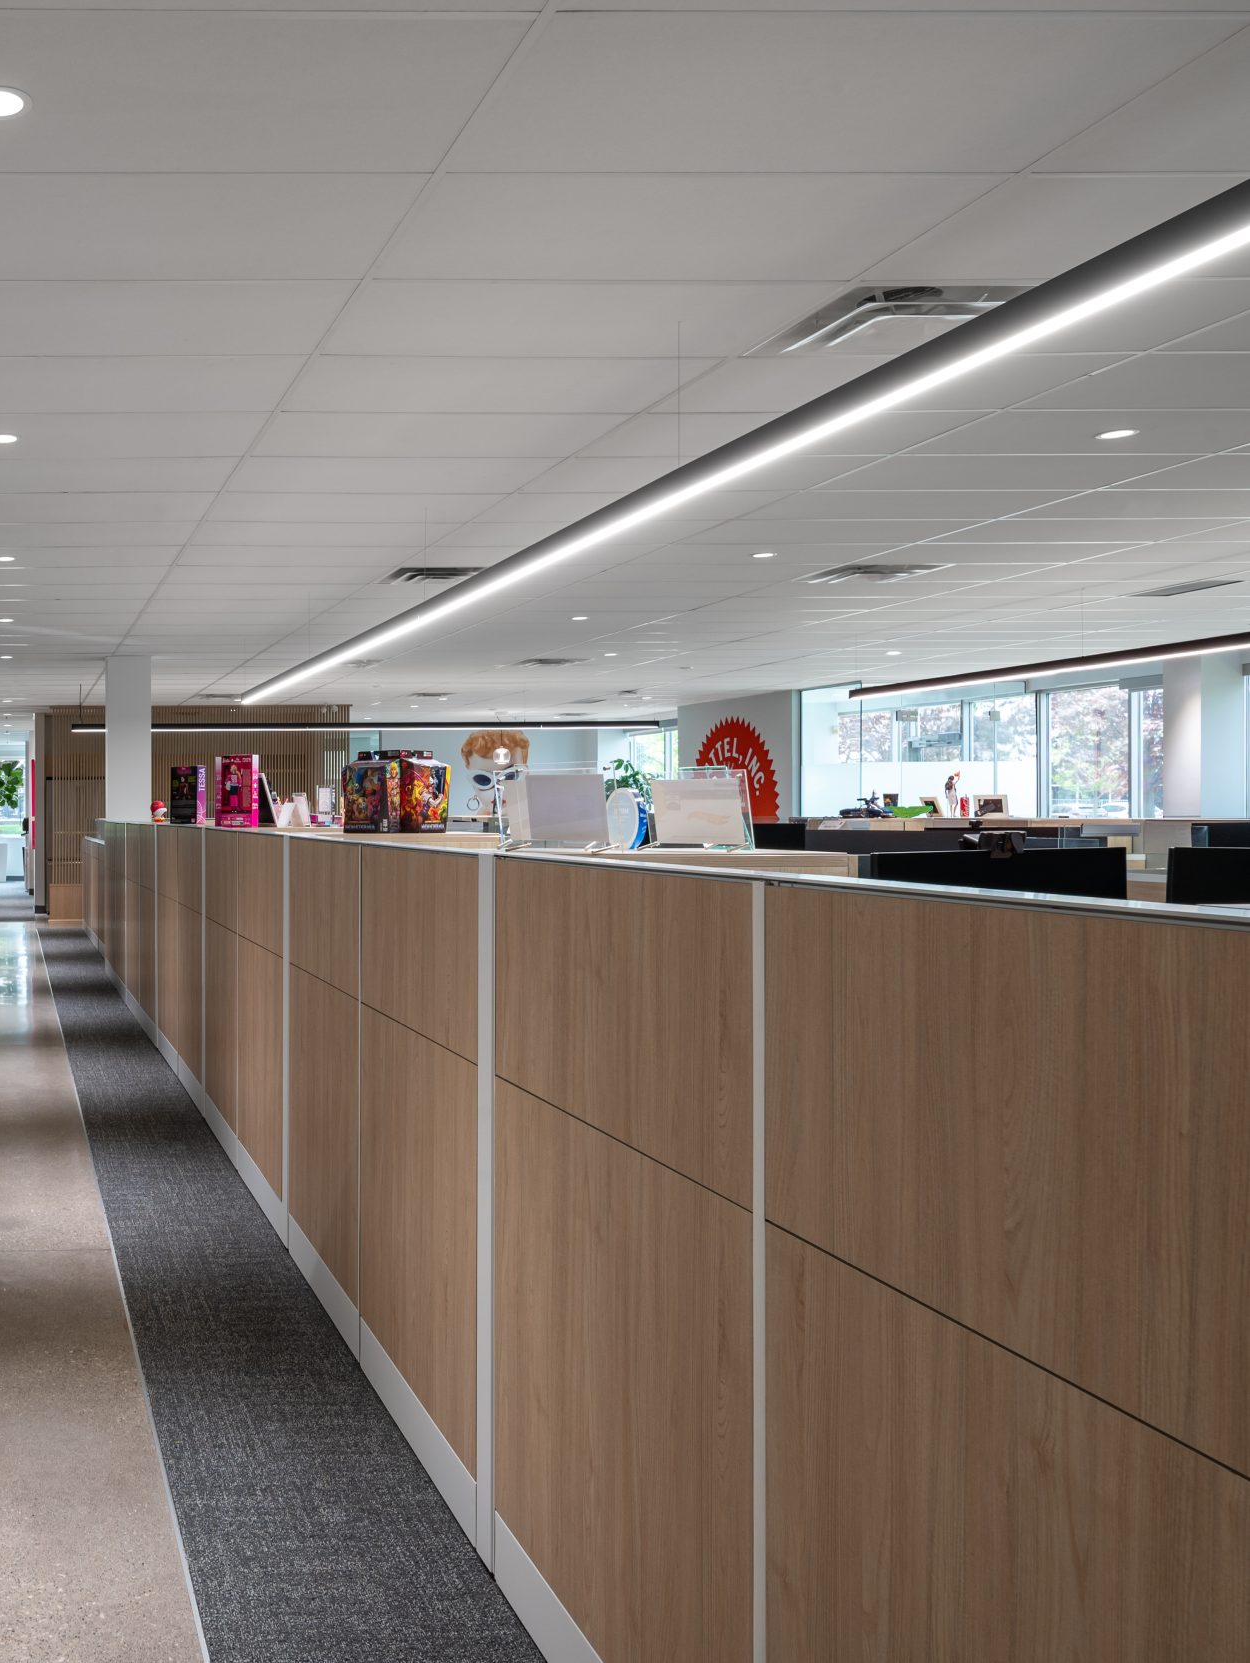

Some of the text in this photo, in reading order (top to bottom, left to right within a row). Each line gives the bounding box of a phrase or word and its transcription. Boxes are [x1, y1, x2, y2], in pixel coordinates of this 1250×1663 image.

[198, 768, 206, 792] TESSA
[705, 737, 765, 796] TTEL, INC.
